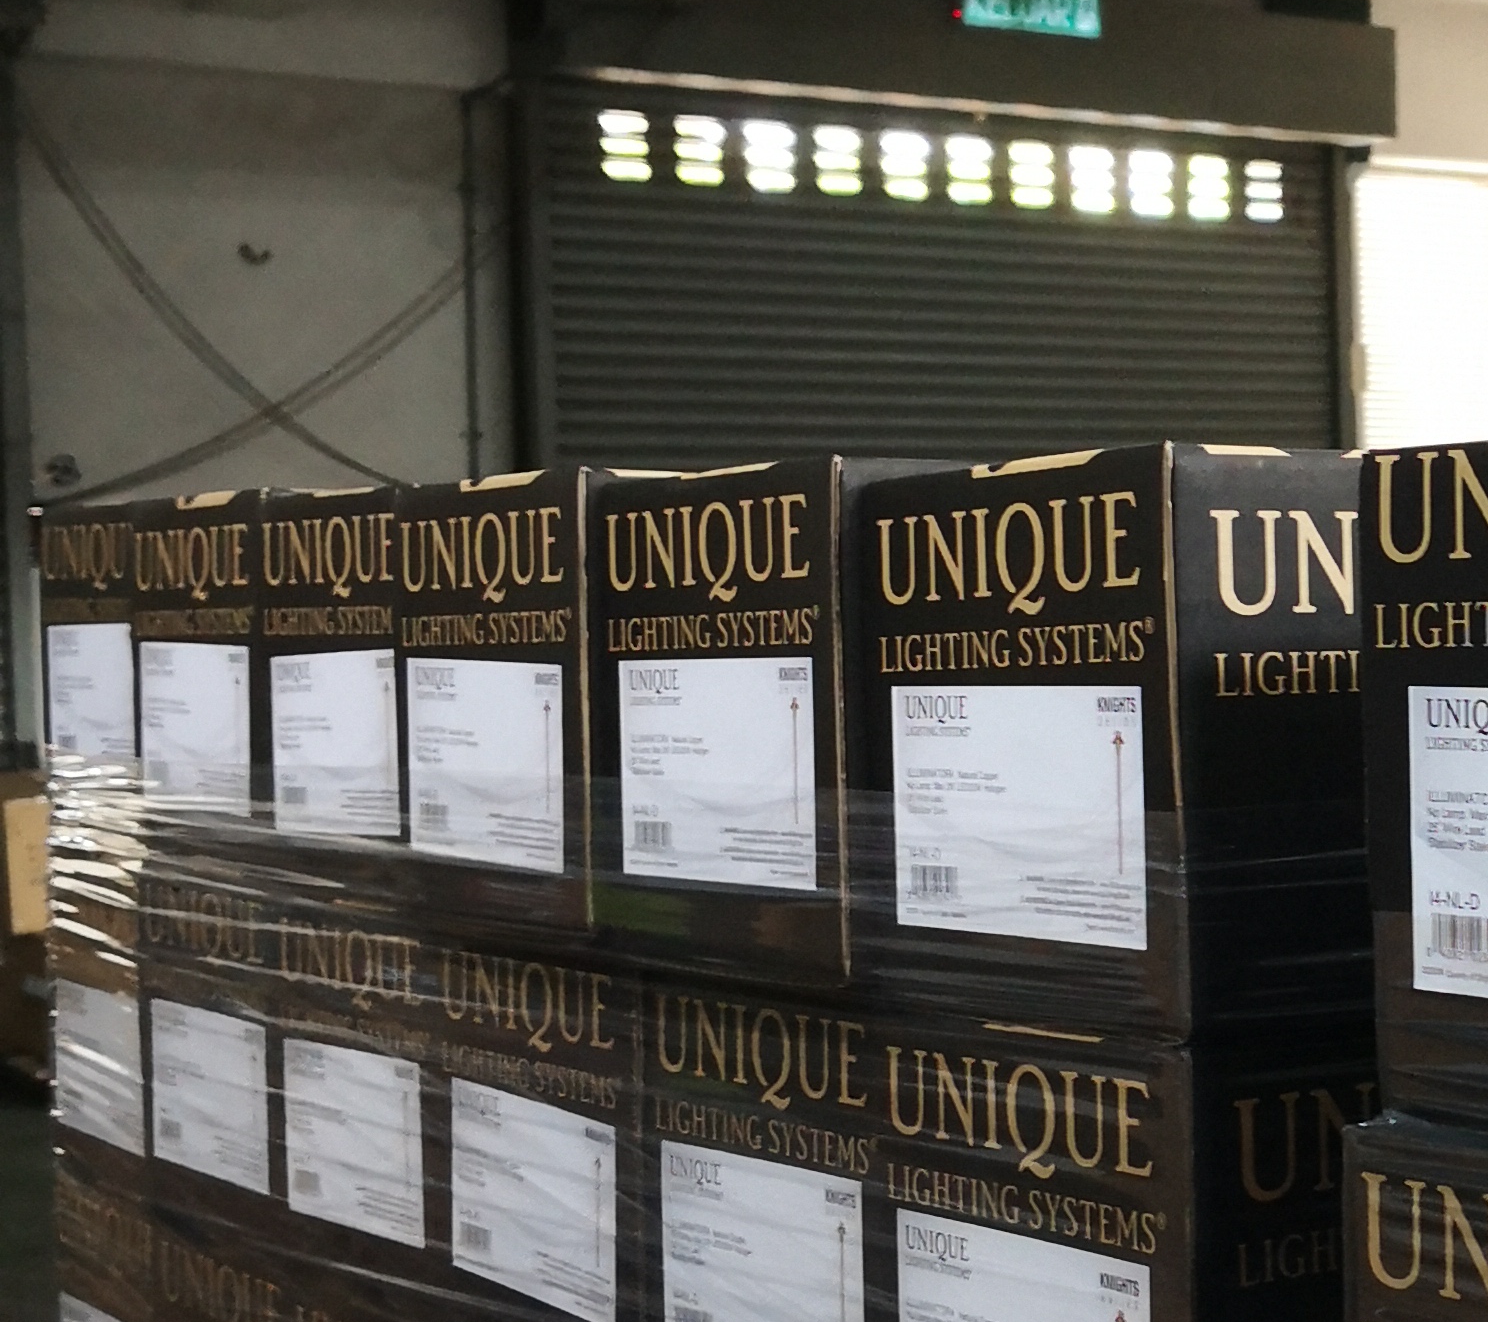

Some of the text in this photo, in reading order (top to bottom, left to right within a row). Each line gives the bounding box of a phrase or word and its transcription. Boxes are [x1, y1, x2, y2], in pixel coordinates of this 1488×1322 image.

[134, 523, 248, 600] UNIQUE
[262, 512, 395, 598] UNIQUE
[401, 506, 564, 603] UNIQUE
[606, 493, 811, 603] UNIQUE
[876, 491, 1141, 615] UNIQUE
[1209, 509, 1359, 616] UN
[402, 613, 484, 648] LIGHTING
[608, 615, 711, 652] LIGHTING
[879, 629, 1011, 673] LIGHTING
[904, 695, 969, 725] UNIQUE
[1213, 649, 1360, 697] LIGHTI
[443, 949, 616, 1053] UNIQUE
[656, 994, 868, 1110] UNIQUE
[655, 1096, 762, 1150] LIGHTING
[887, 1045, 1153, 1179] UNIQUE
[888, 1163, 1021, 1225] LIGHTING
[905, 1224, 970, 1262] UNIQUE
